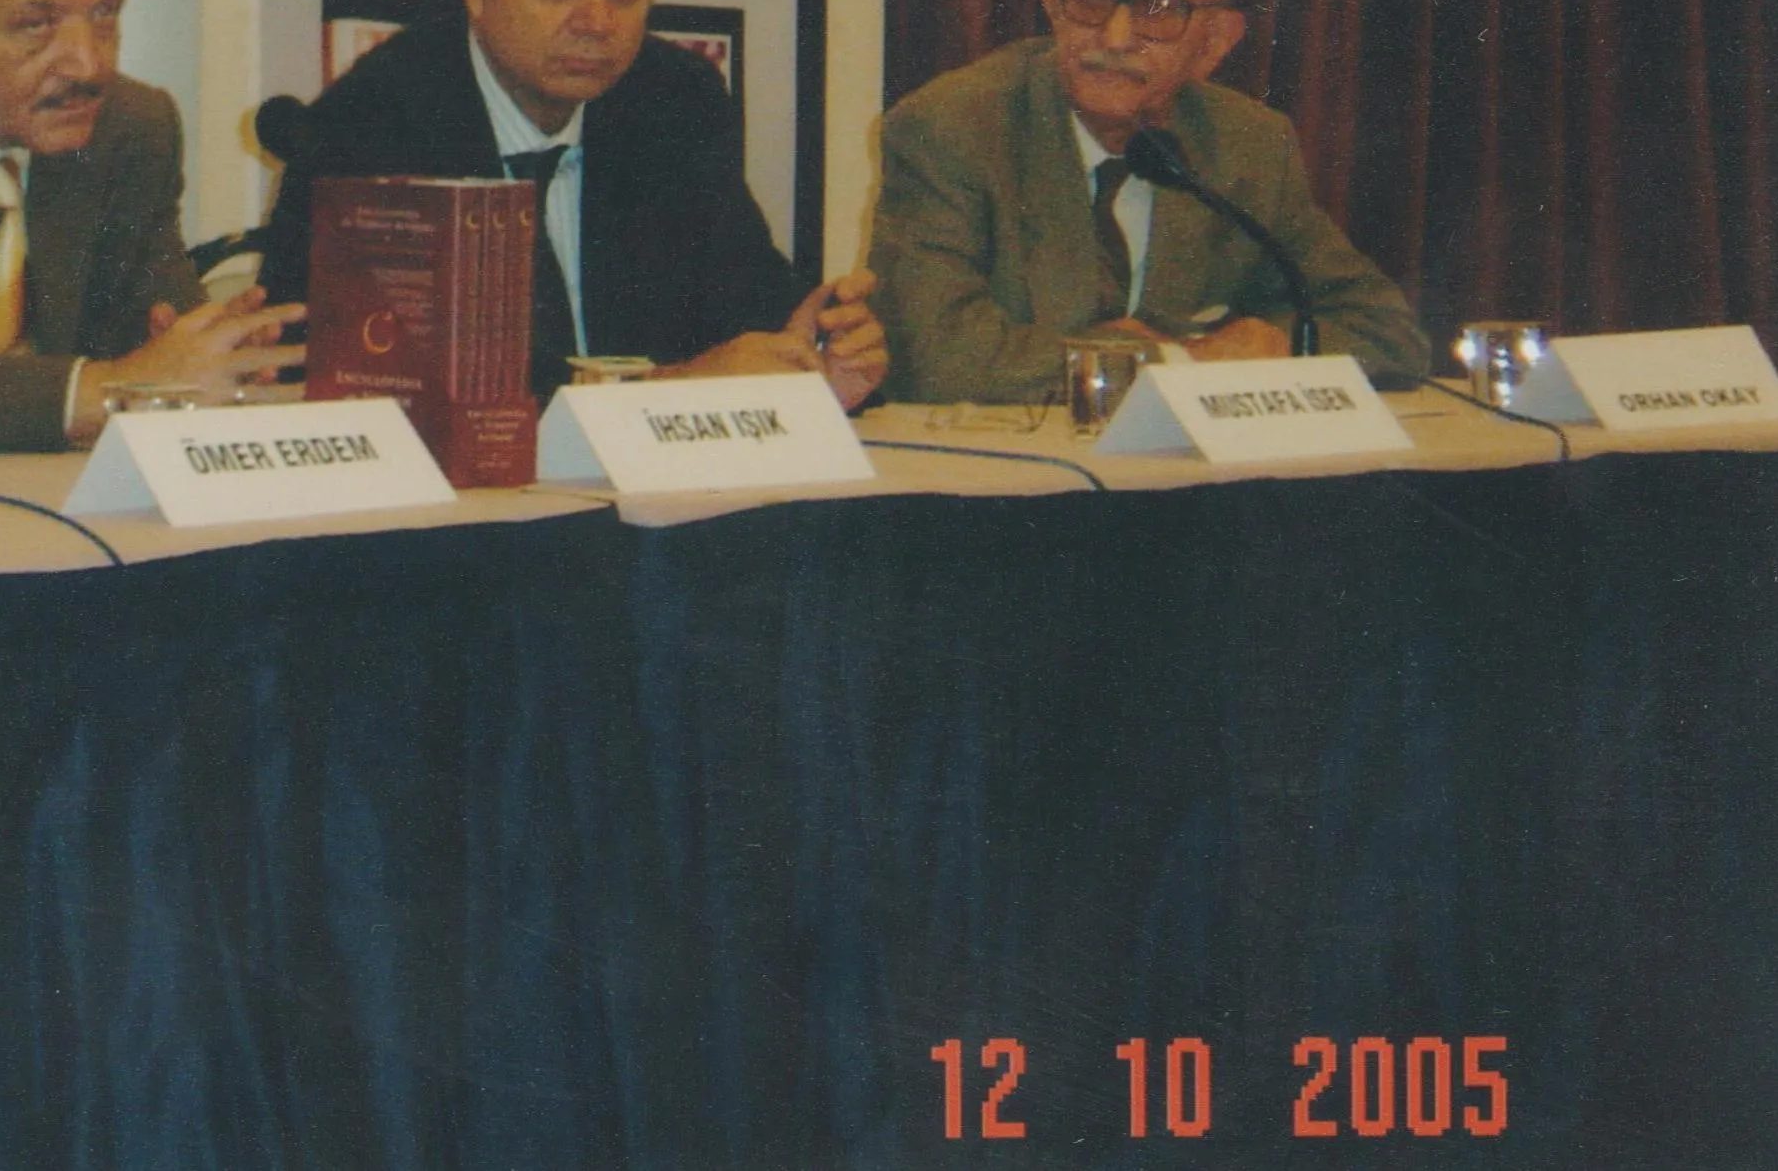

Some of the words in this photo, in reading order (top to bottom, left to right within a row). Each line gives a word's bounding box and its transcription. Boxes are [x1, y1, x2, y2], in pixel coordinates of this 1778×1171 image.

[642, 407, 733, 443] İHSAN
[729, 408, 790, 444] IŞIK
[180, 436, 276, 475] ÖMER
[274, 433, 380, 467] ERDEM
